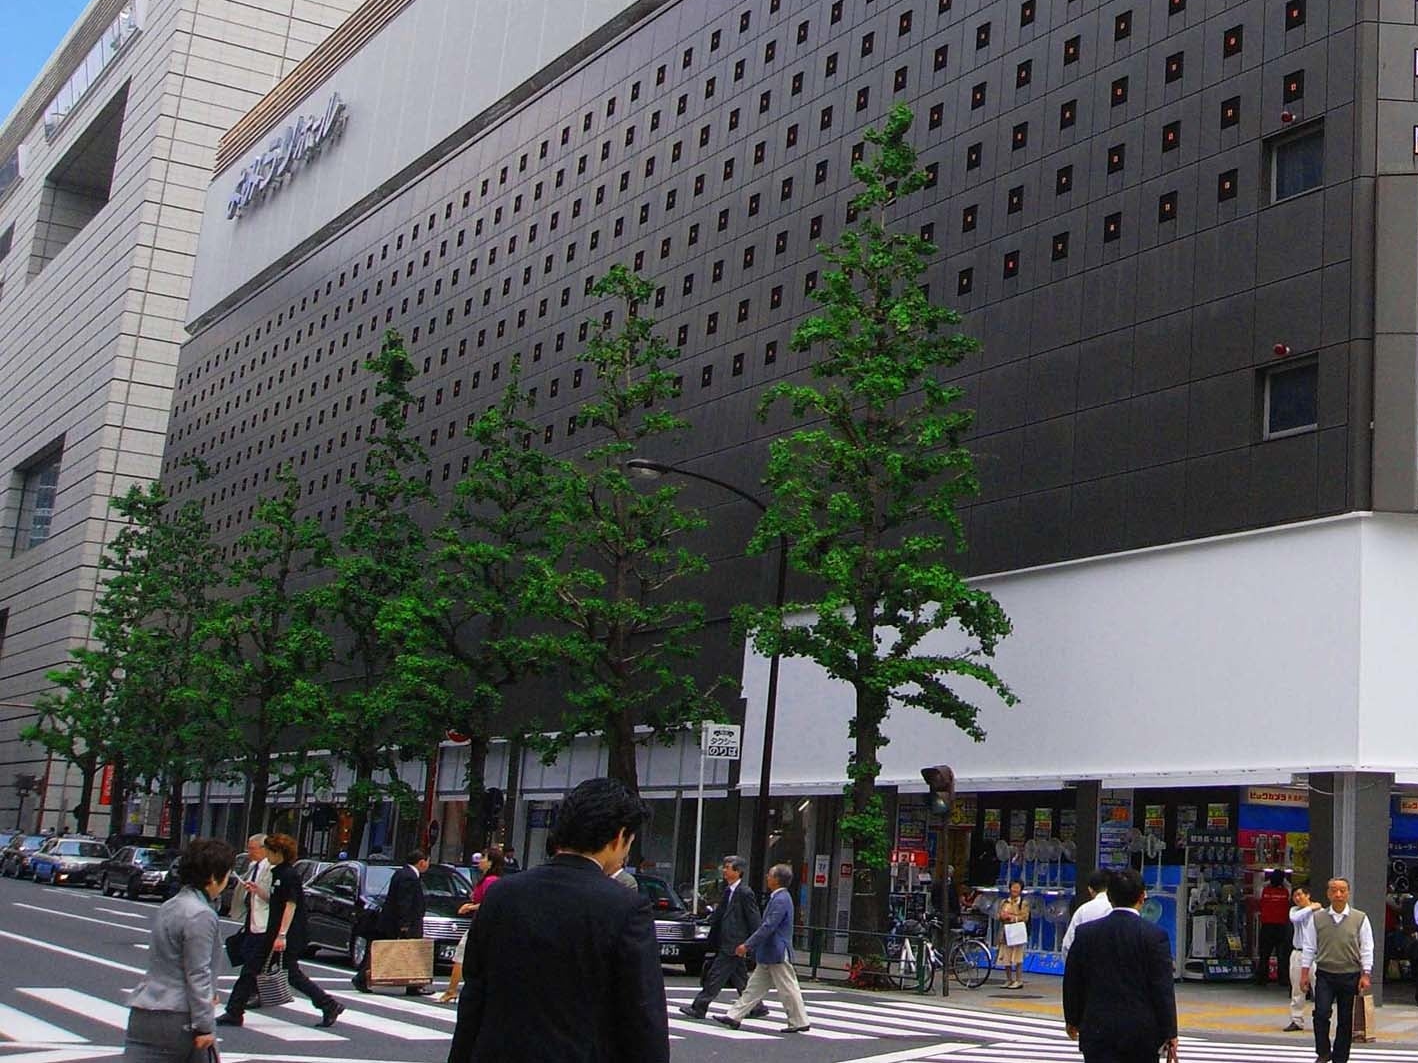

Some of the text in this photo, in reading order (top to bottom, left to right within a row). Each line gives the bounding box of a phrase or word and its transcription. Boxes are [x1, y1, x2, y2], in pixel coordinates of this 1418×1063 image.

[710, 737, 737, 746] タクシー
[709, 746, 737, 756] のりば
